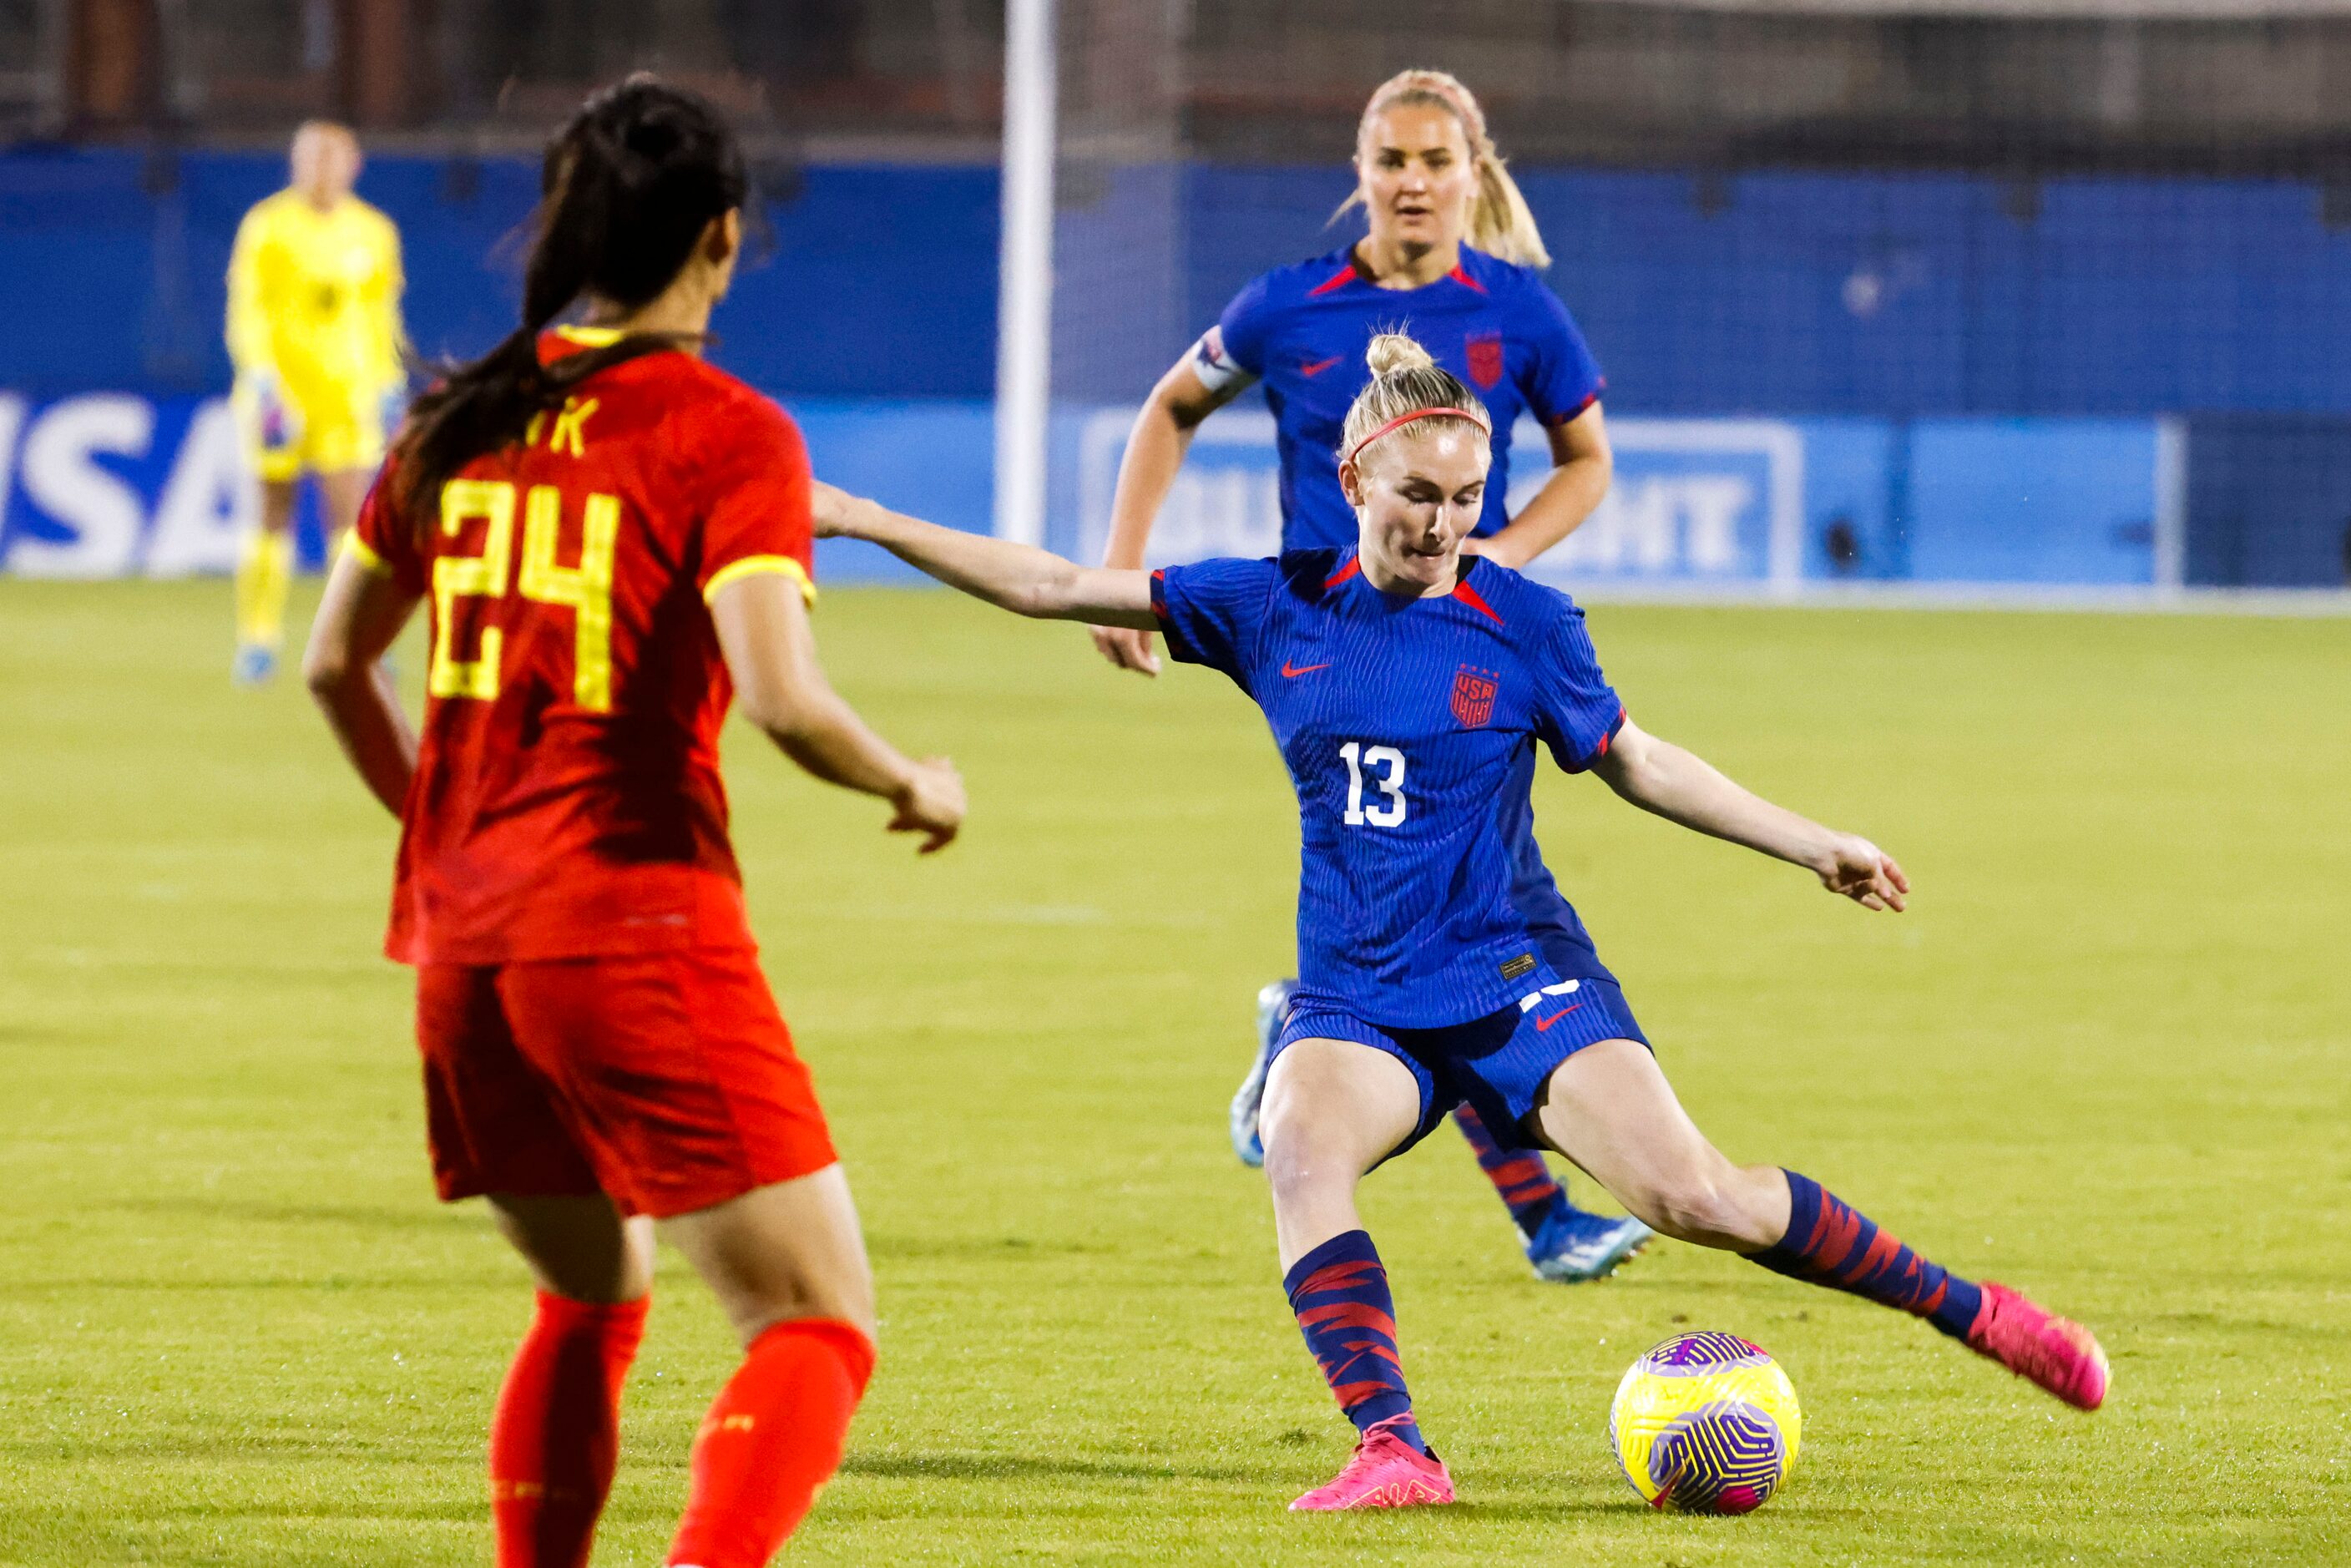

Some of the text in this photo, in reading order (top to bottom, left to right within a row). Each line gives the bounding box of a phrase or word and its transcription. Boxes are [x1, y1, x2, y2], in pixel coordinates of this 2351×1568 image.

[430, 478, 620, 713] 24
[1457, 675, 1494, 700] USA
[1339, 741, 1406, 827] 13
